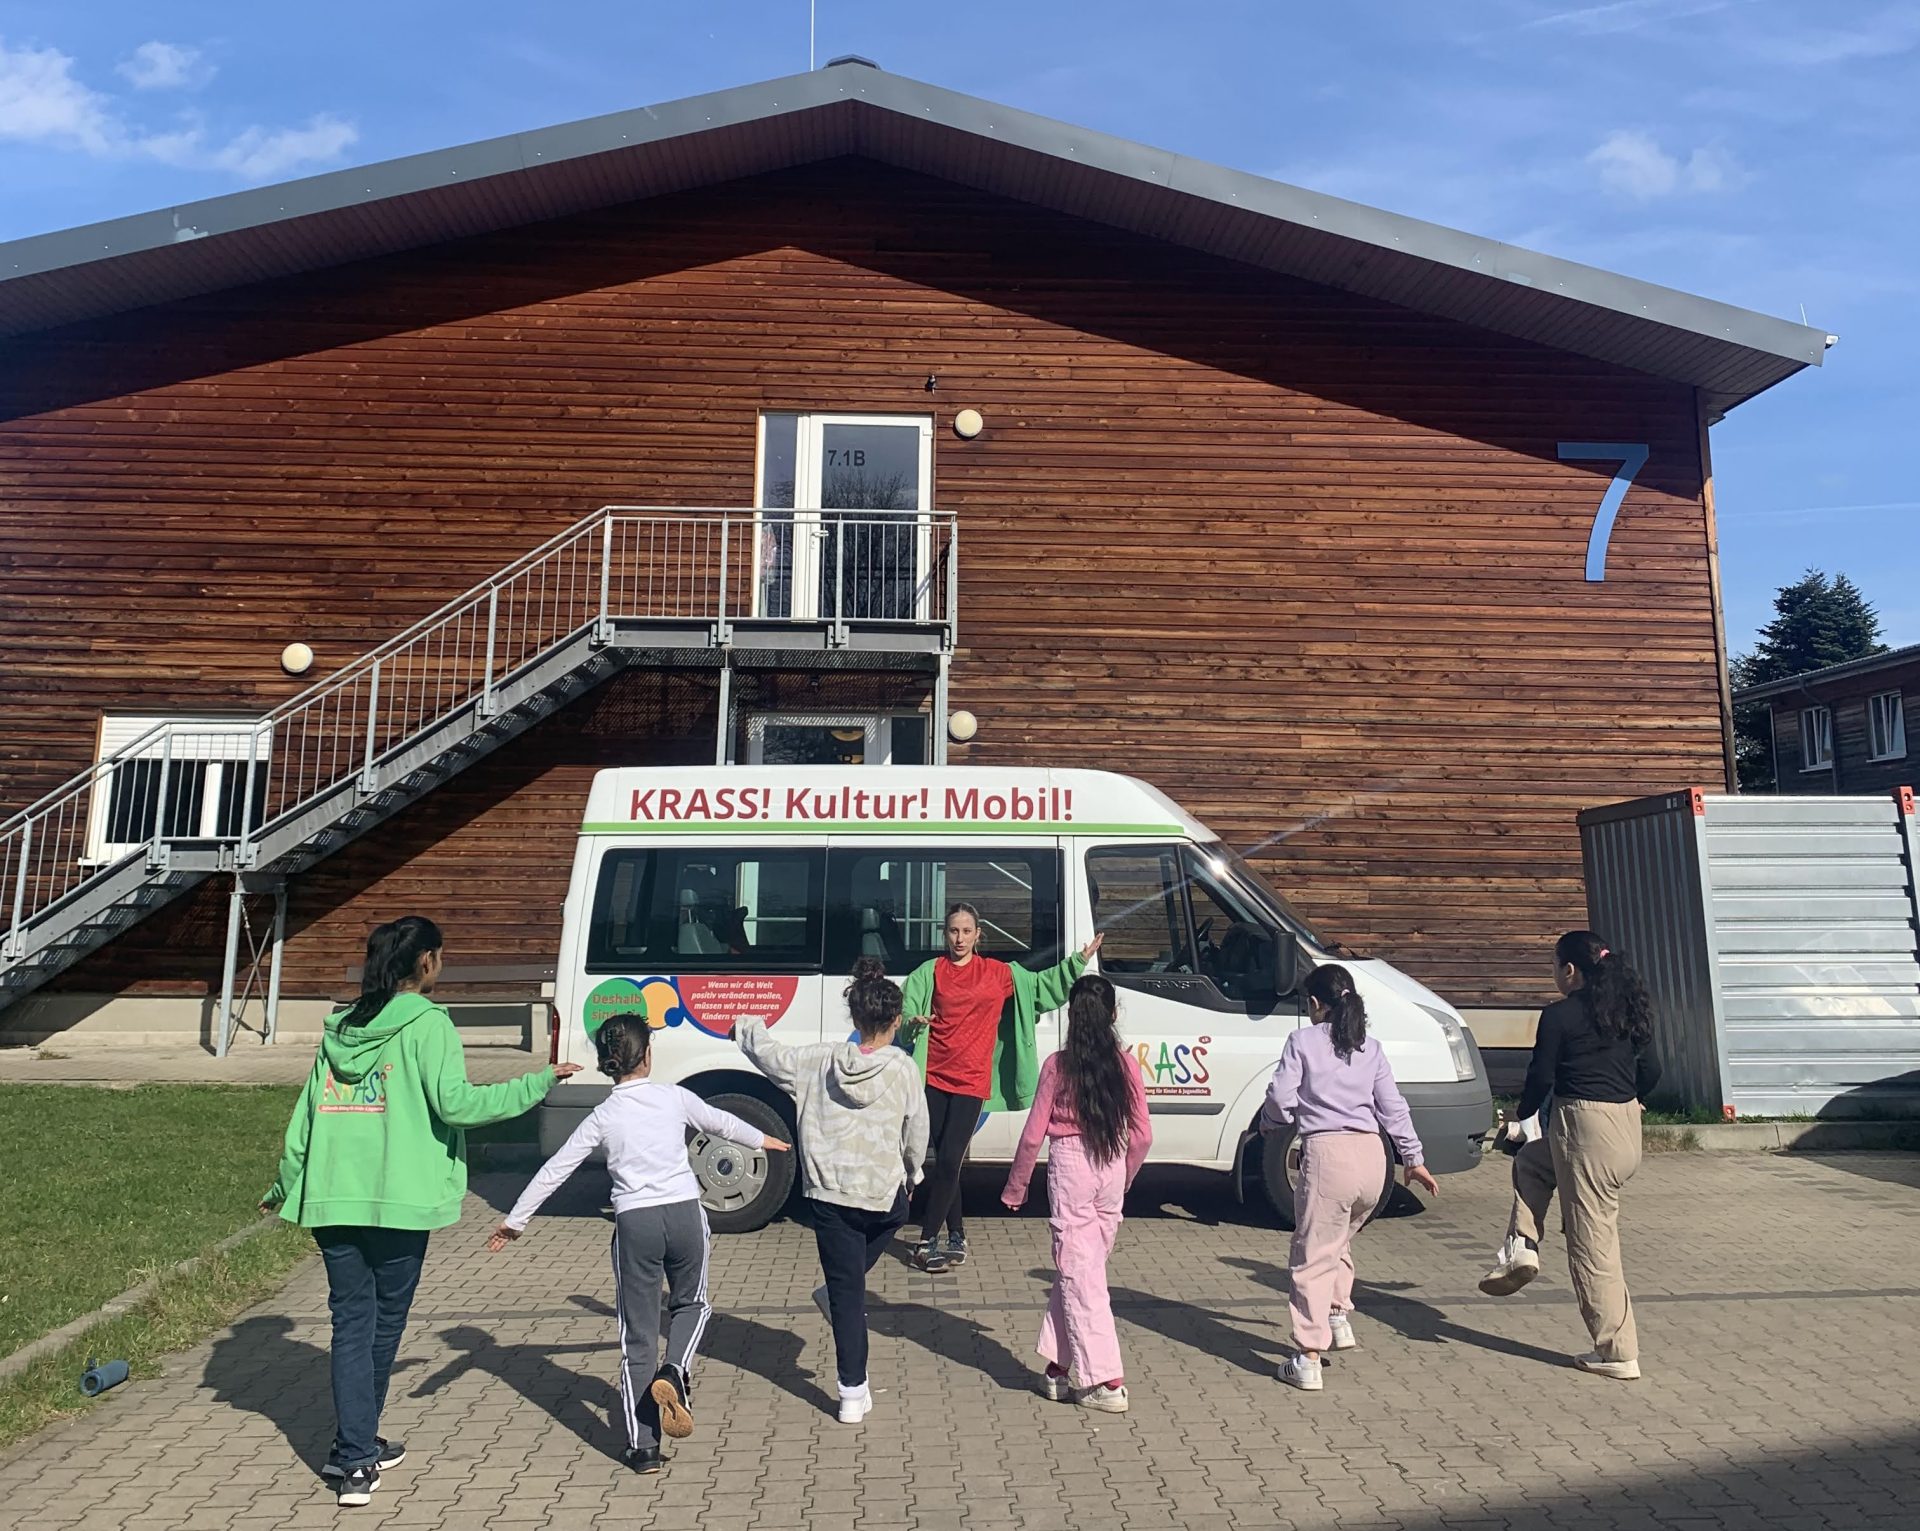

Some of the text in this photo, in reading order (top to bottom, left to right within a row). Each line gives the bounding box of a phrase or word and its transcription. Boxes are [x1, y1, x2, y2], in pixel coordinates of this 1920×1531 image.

[828, 449, 865, 466] 7.1B
[1557, 441, 1650, 581] 7
[630, 786, 1073, 821] KRASS! Kultur! Mobil!
[729, 981, 742, 989] wir
[743, 981, 755, 989] die
[756, 981, 774, 989] Welt
[1142, 979, 1201, 989] TRANST
[592, 993, 642, 1005] Deshalb
[691, 991, 783, 1000] positiv verändern wollen,
[694, 1002, 725, 1010] müssen
[726, 1002, 736, 1010] wir
[736, 1002, 749, 1010] bei
[701, 1012, 730, 1020] Kindern
[1125, 1042, 1210, 1085] RASS
